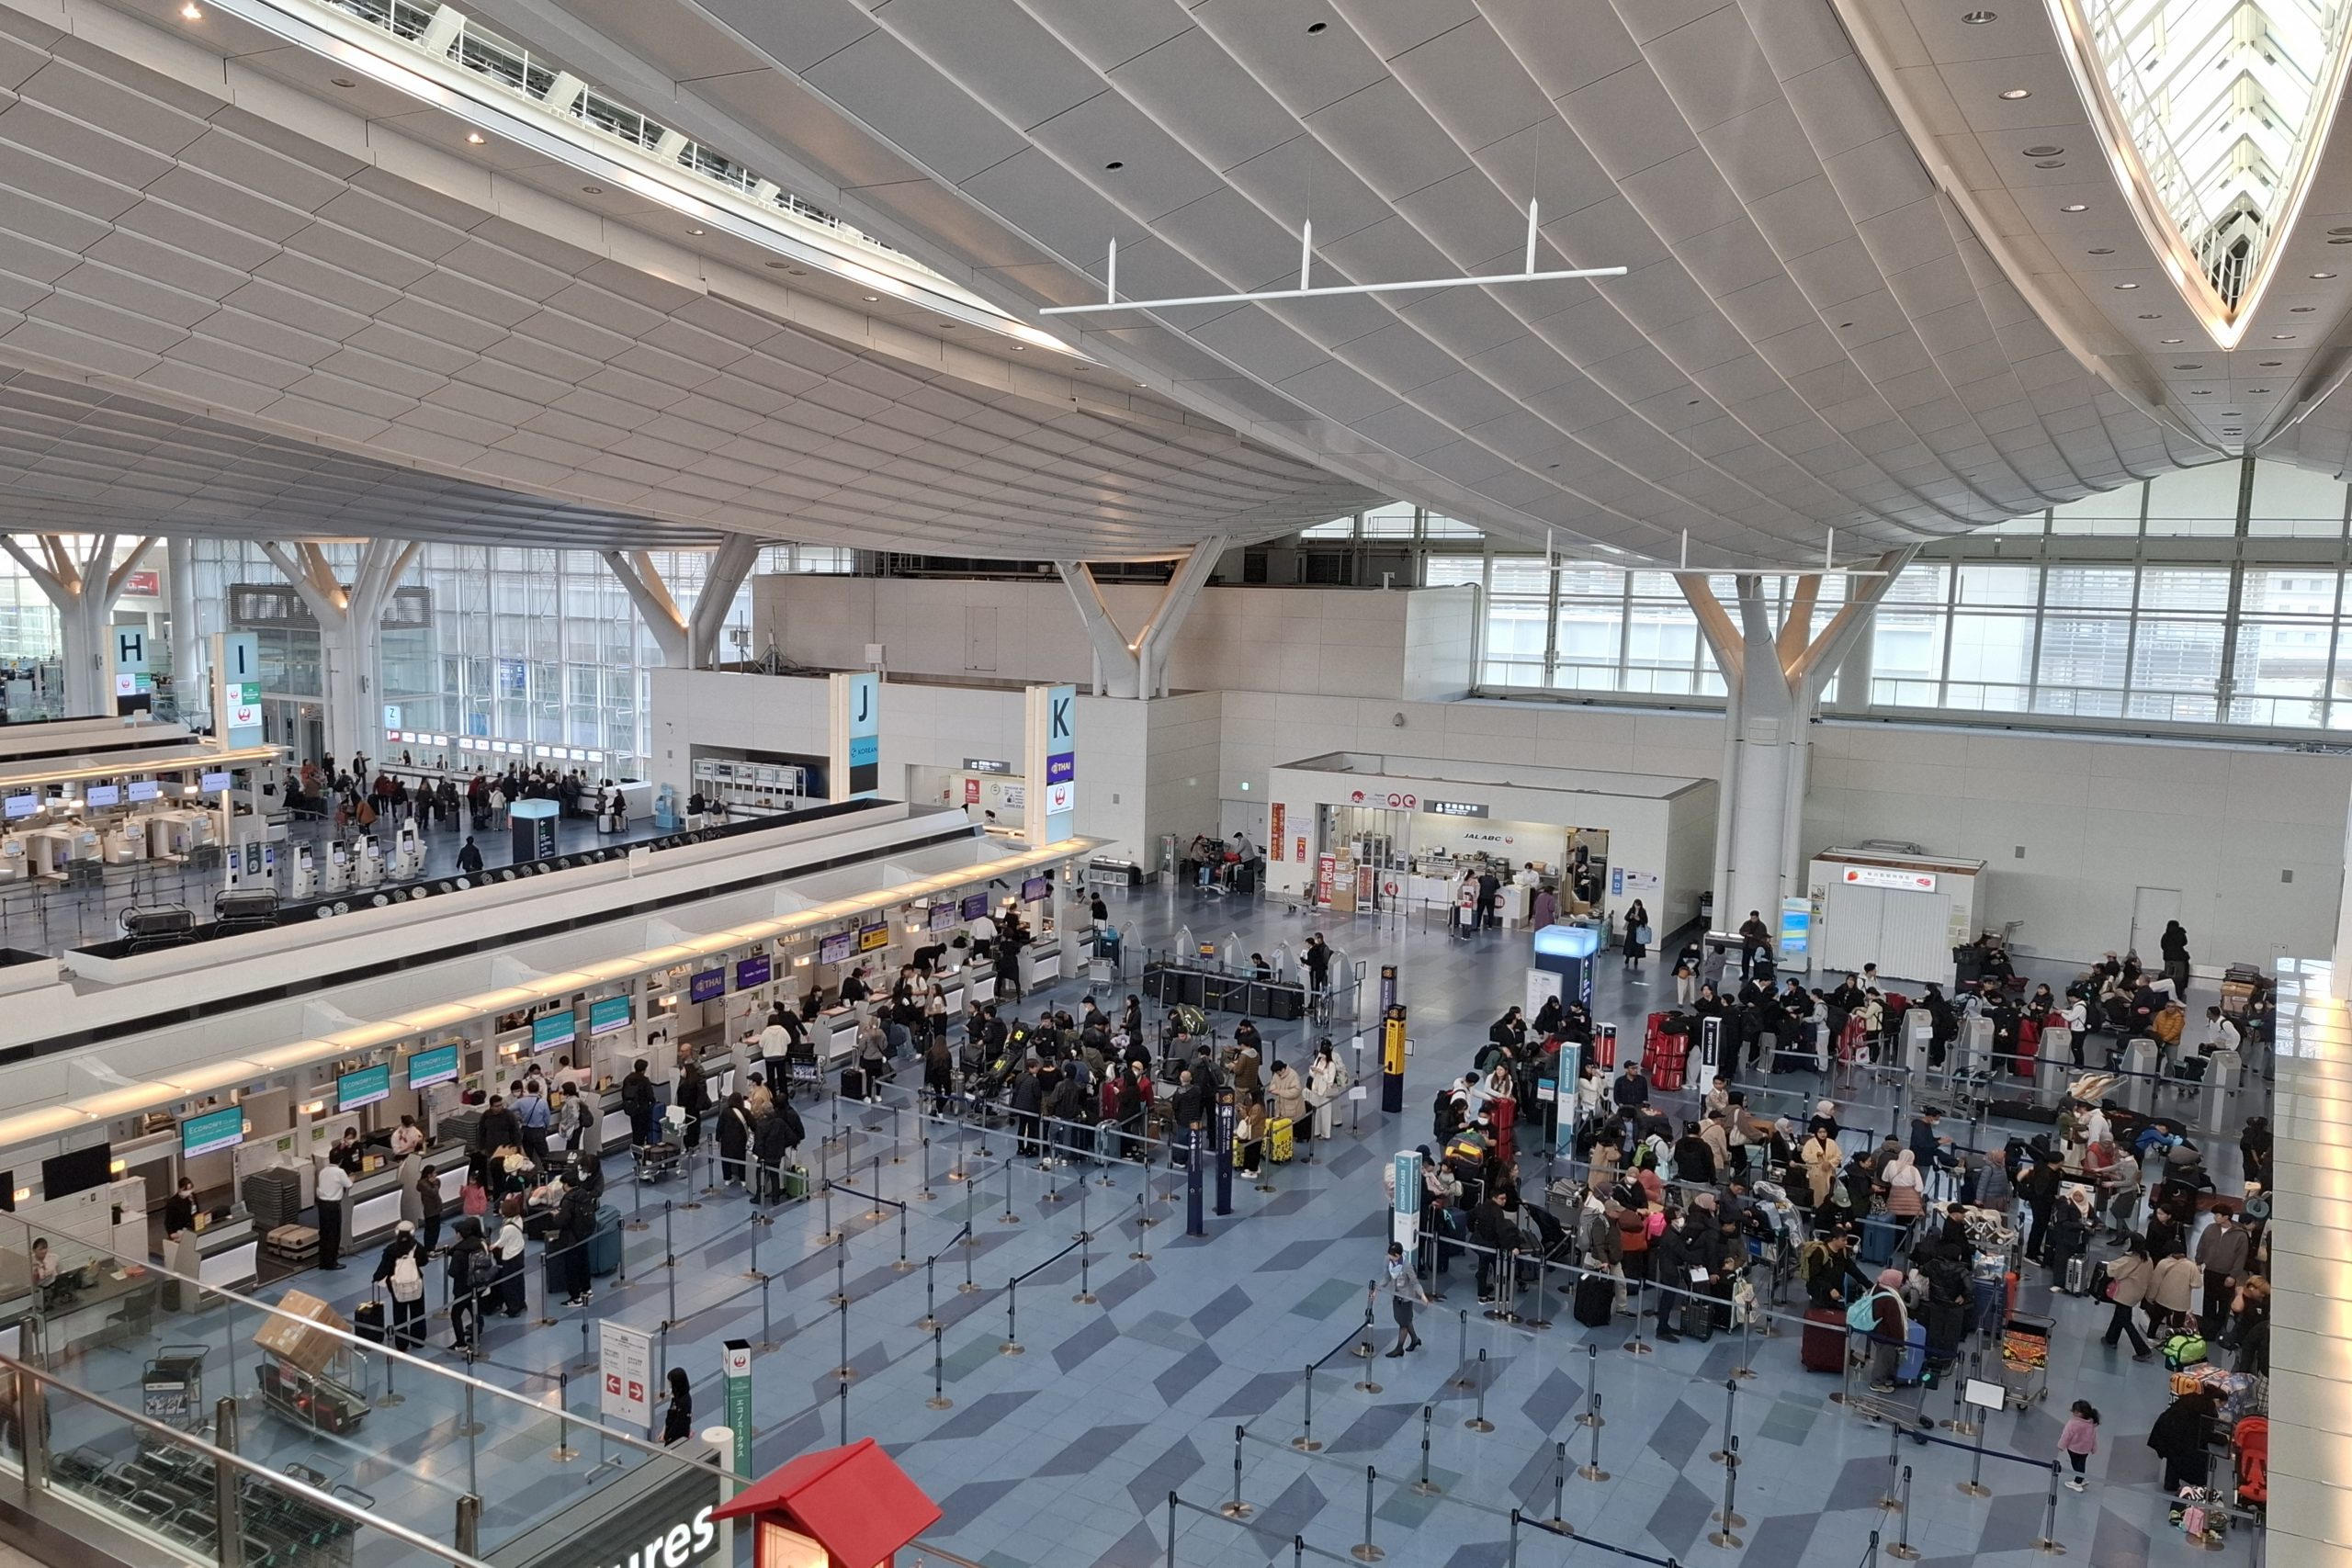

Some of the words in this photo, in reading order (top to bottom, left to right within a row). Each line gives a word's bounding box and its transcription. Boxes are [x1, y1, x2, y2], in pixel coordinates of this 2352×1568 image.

[120, 633, 142, 662] H
[237, 645, 245, 674] I
[858, 684, 868, 723] J
[1053, 697, 1071, 739] K
[1057, 761, 1071, 772] THAI
[1076, 869, 1085, 885] K
[675, 979, 682, 987] 5
[705, 976, 722, 989] THAI
[463, 1039, 471, 1050] 8
[583, 1039, 590, 1049] 7
[736, 1399, 744, 1458] エコノミークラス
